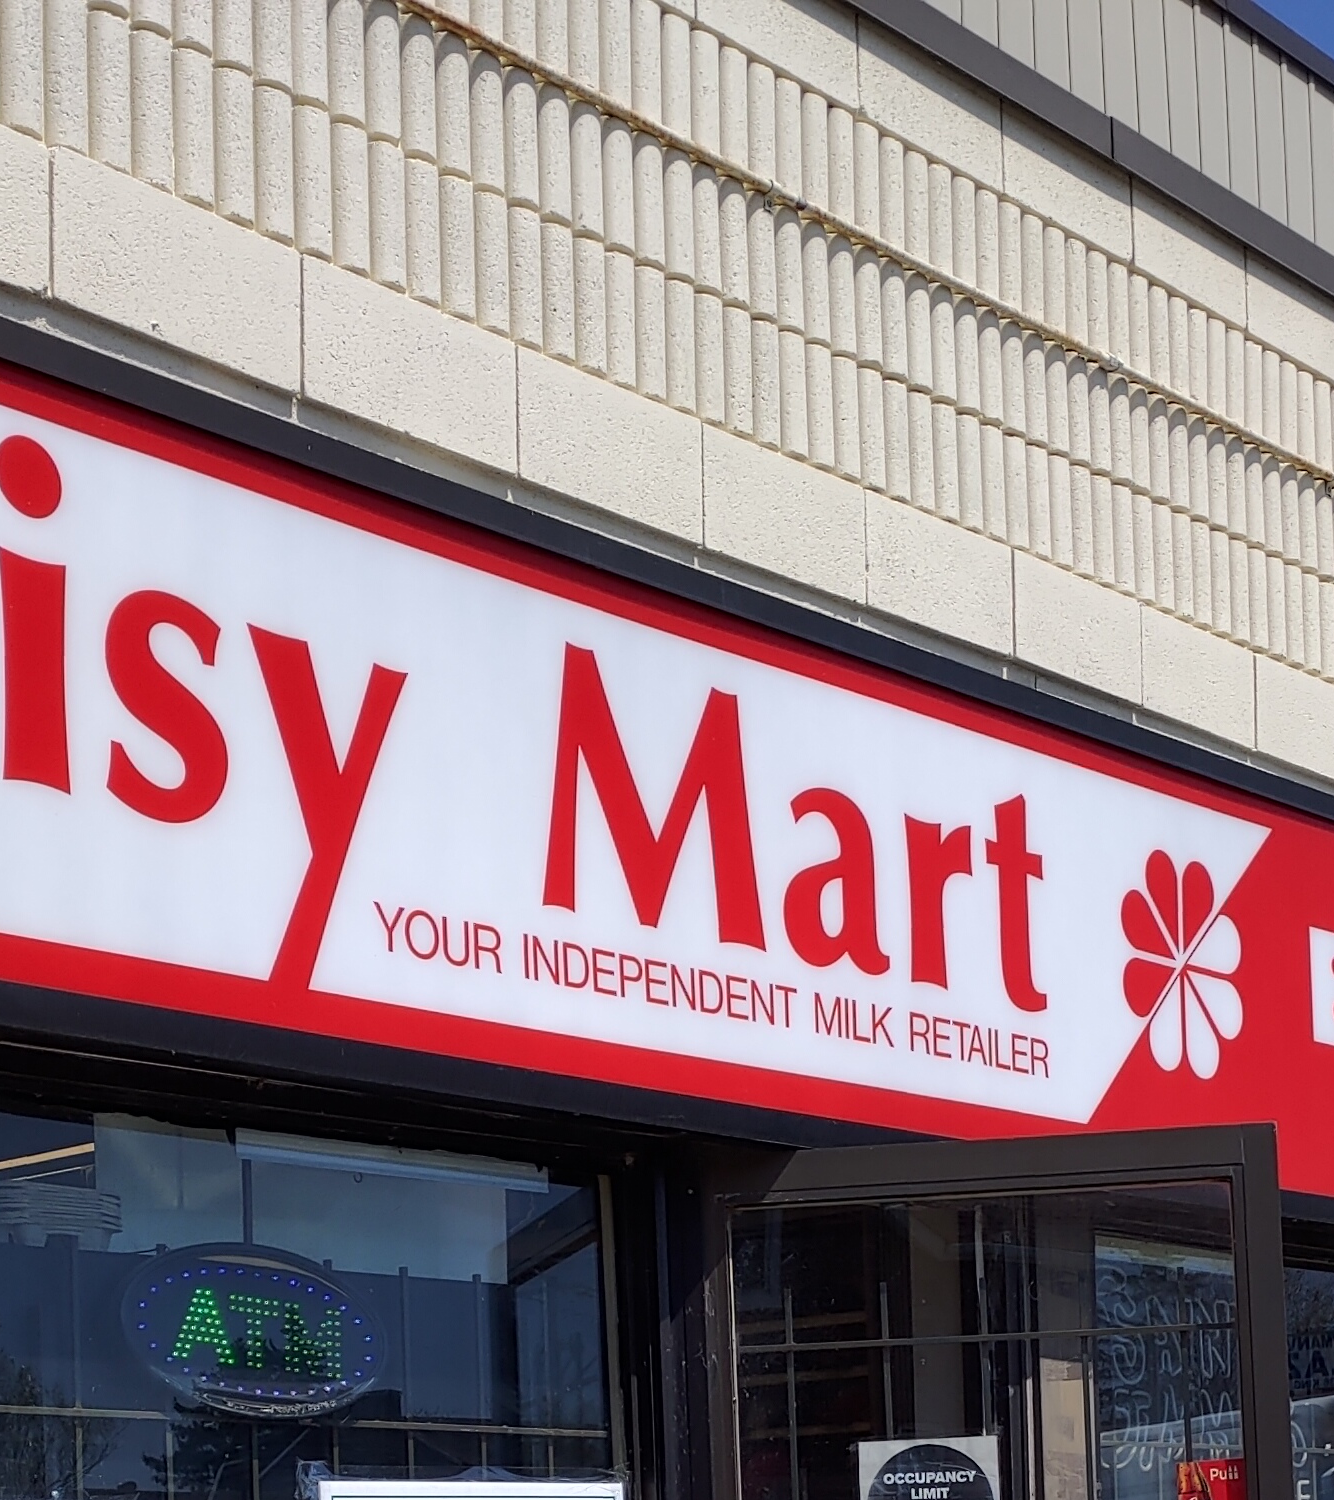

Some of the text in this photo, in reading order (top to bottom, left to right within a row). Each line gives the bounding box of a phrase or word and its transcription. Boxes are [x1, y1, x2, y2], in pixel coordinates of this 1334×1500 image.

[541, 641, 1048, 1013] Mart
[373, 901, 1050, 1079] YOUR INDEPENDENT MILK RETAILER
[172, 1285, 344, 1379] ATM
[883, 1470, 977, 1485] OCCUPANCY
[910, 1487, 950, 1500] LIMIT
